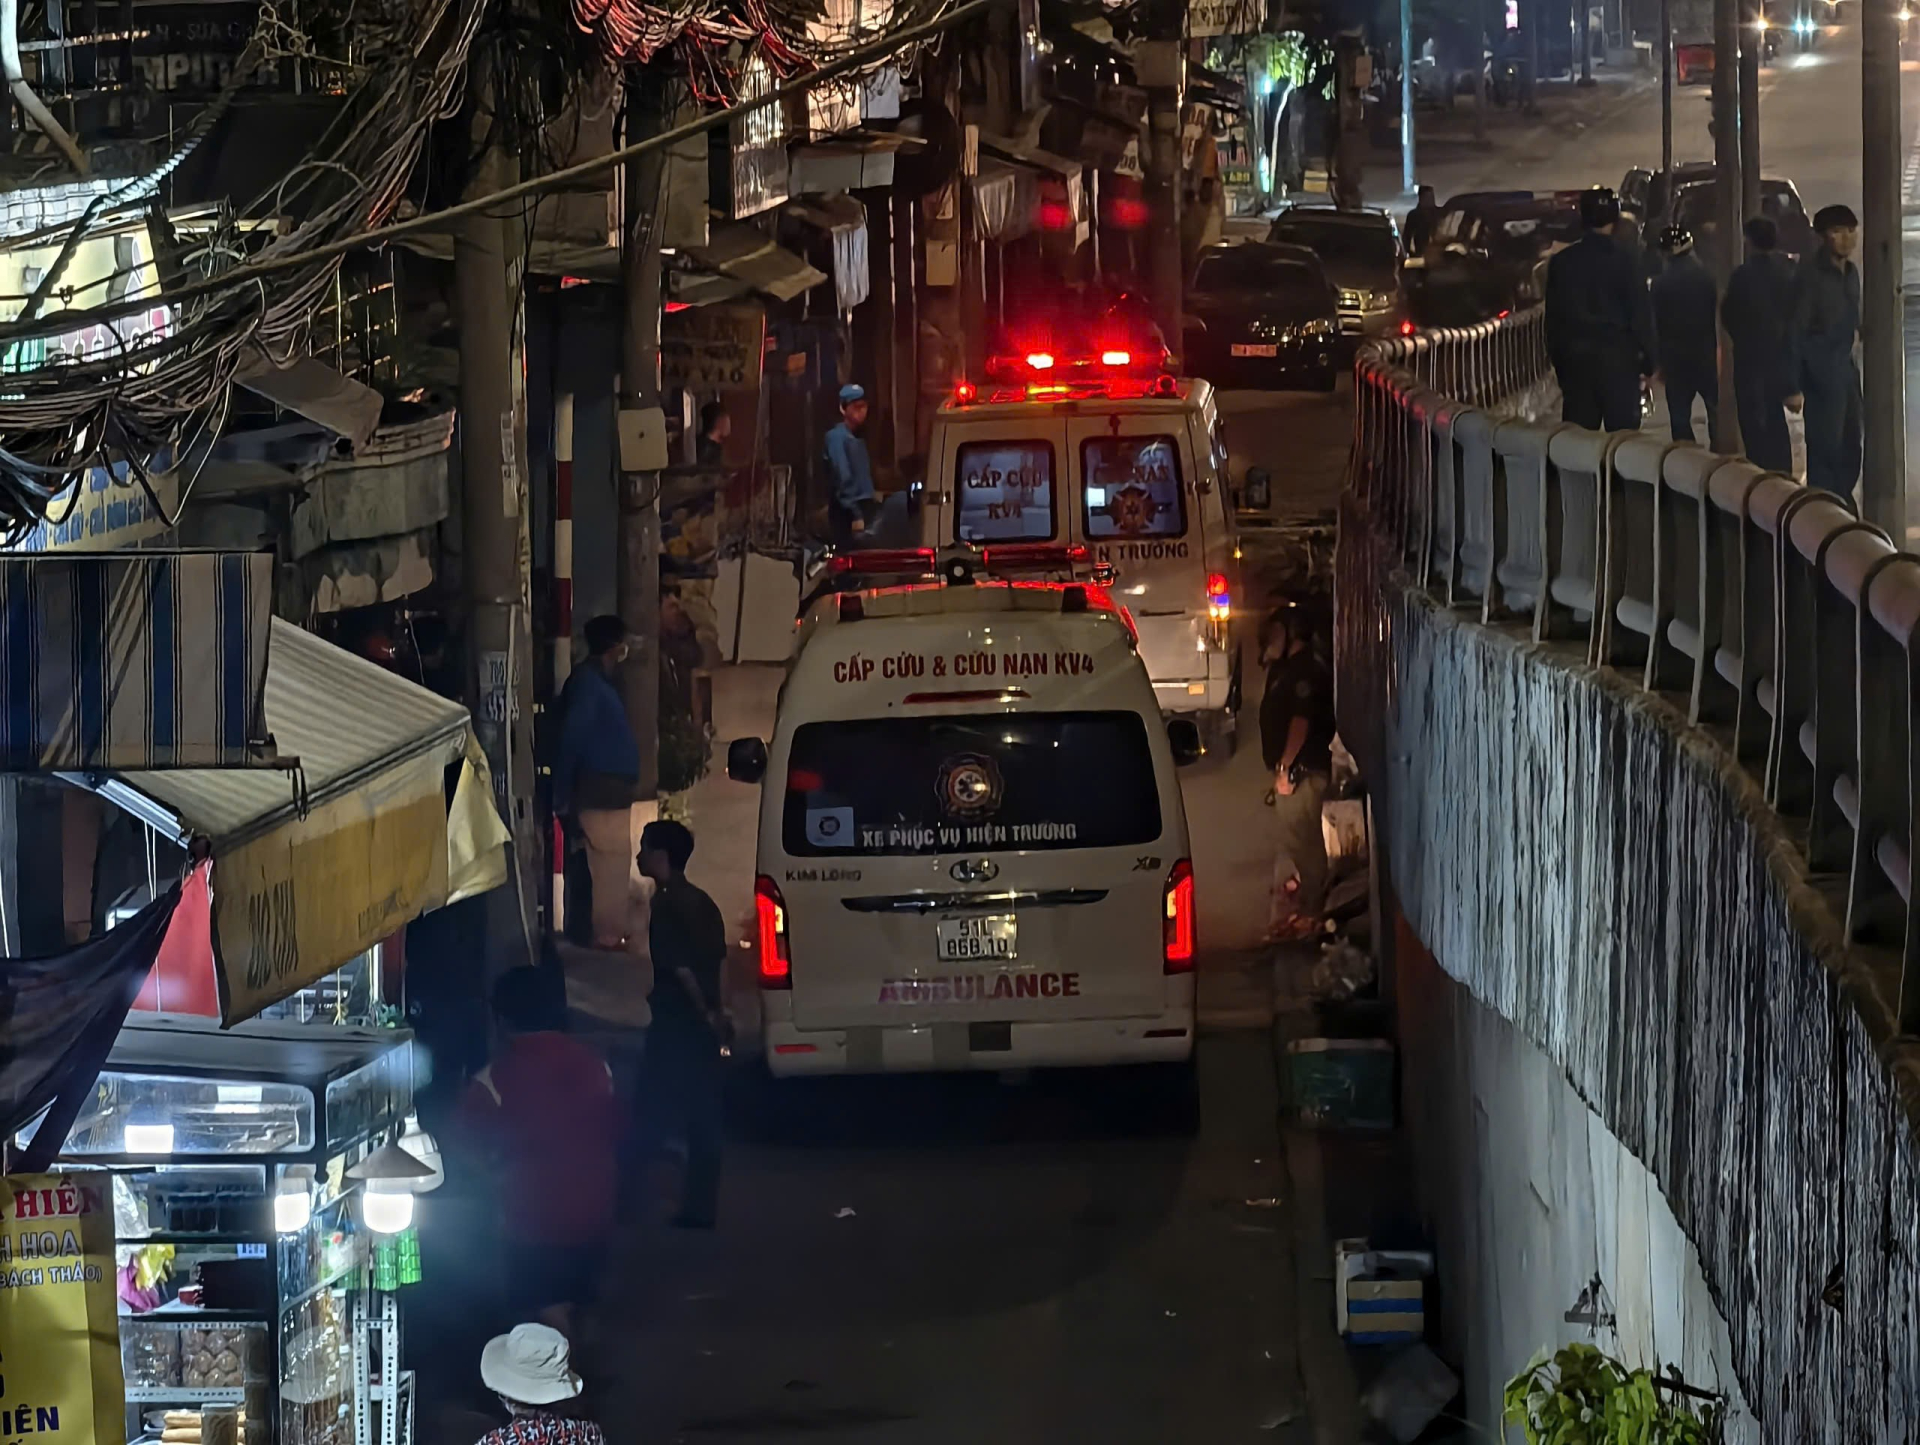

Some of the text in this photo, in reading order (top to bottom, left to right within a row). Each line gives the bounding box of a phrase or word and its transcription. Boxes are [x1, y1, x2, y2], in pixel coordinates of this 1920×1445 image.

[833, 649, 1094, 684] CẤP CỨU & CỨU NẠN KV4
[939, 827, 961, 849] VỤ
[878, 972, 1081, 1003] AMBULANCE
[20, 1229, 81, 1260] HOA
